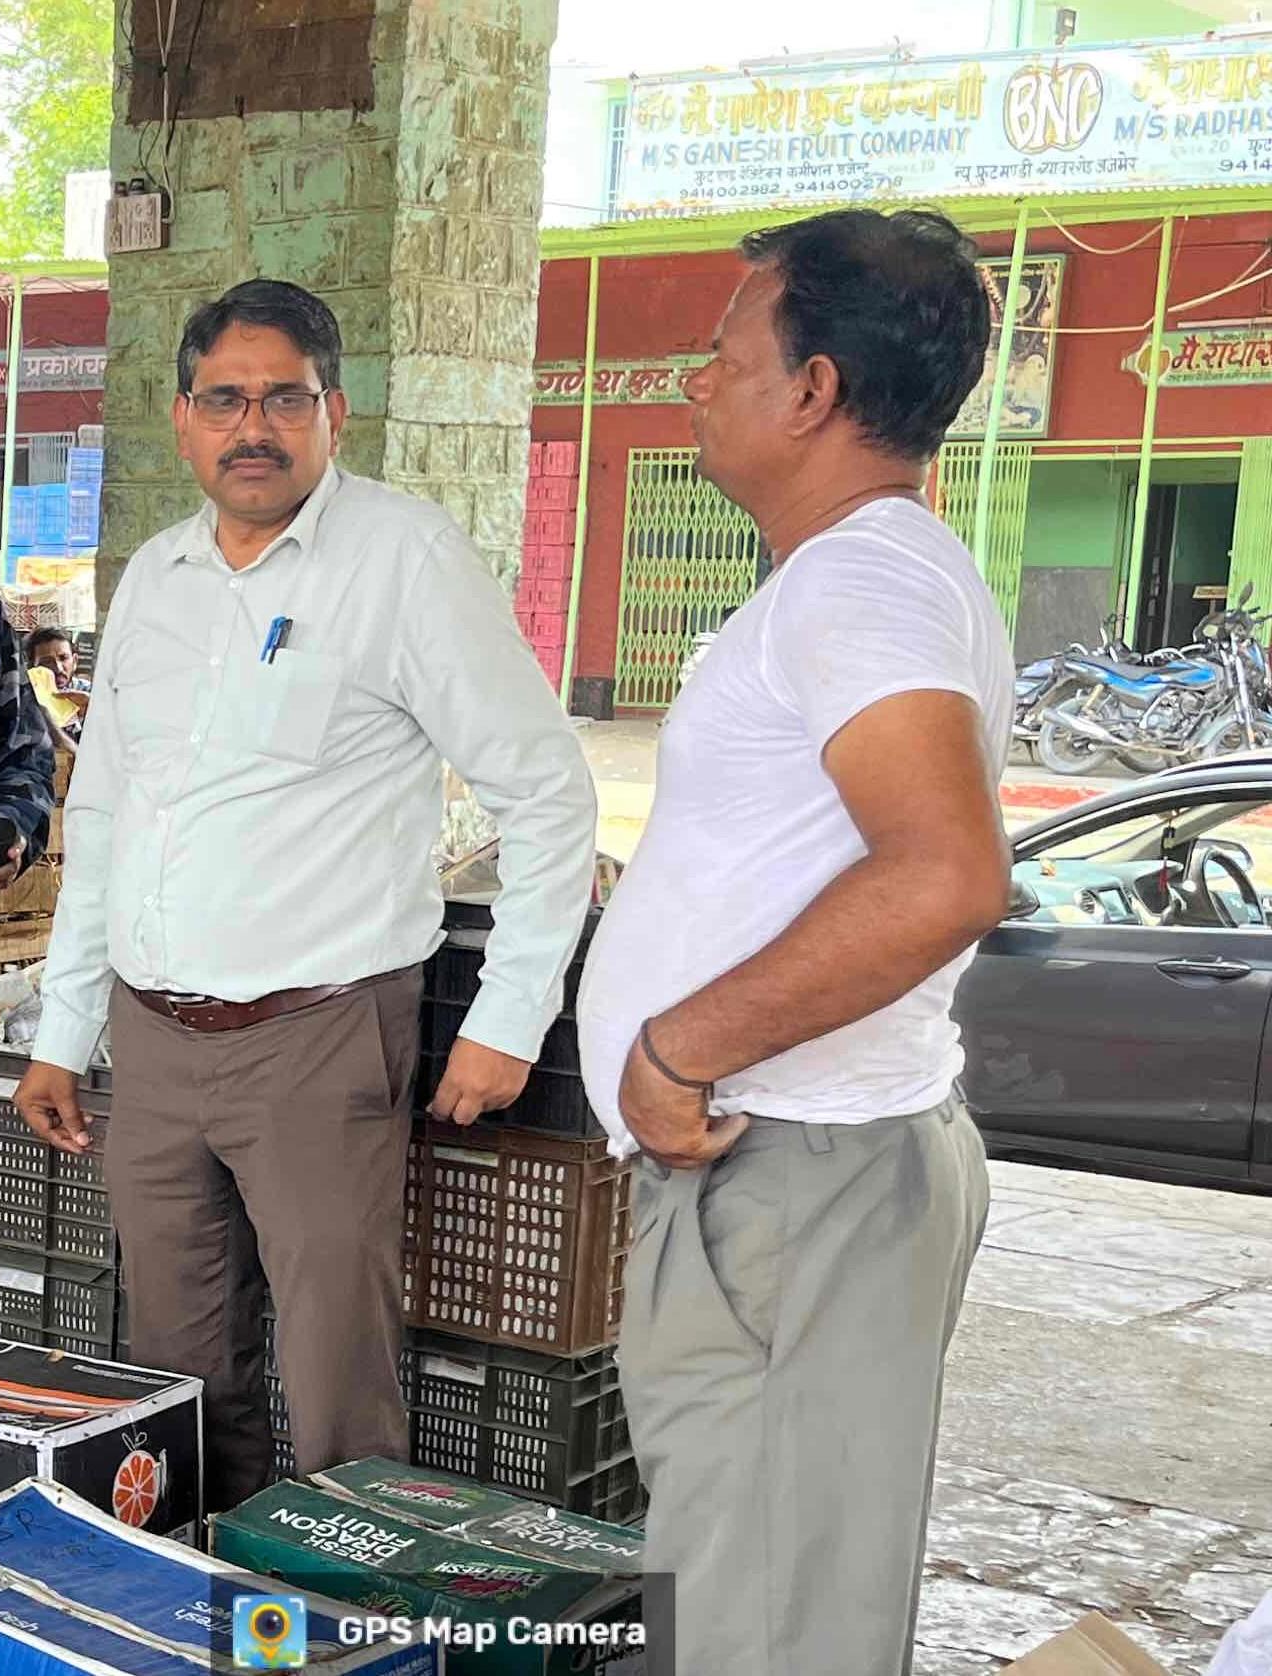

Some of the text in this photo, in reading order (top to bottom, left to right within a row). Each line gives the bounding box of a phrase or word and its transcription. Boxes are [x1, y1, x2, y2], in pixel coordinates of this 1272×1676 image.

[1005, 63, 1104, 154] BNC
[685, 138, 784, 165] GANESH
[788, 133, 858, 160] FRUIT
[860, 127, 970, 156] COMPANY
[269, 1508, 401, 1559] DRAGON
[321, 1513, 417, 1549] FRUIT
